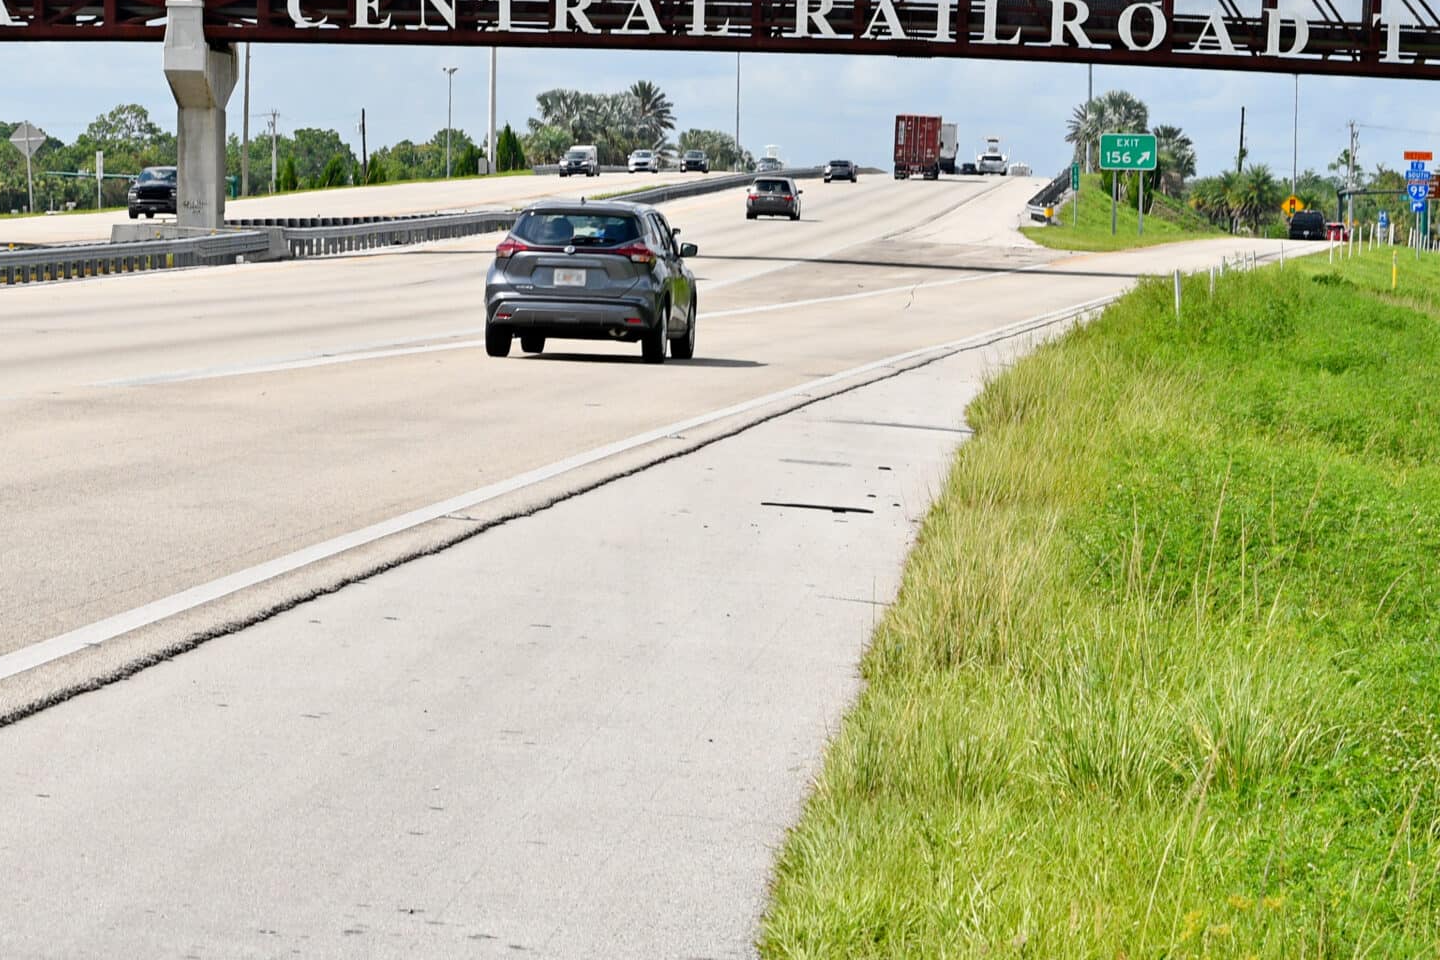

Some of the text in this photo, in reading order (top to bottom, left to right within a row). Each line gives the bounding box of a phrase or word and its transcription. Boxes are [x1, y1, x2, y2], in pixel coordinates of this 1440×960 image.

[1116, 139, 1139, 147] EXIT
[1106, 151, 1131, 164] 156
[1410, 185, 1425, 197] 95
